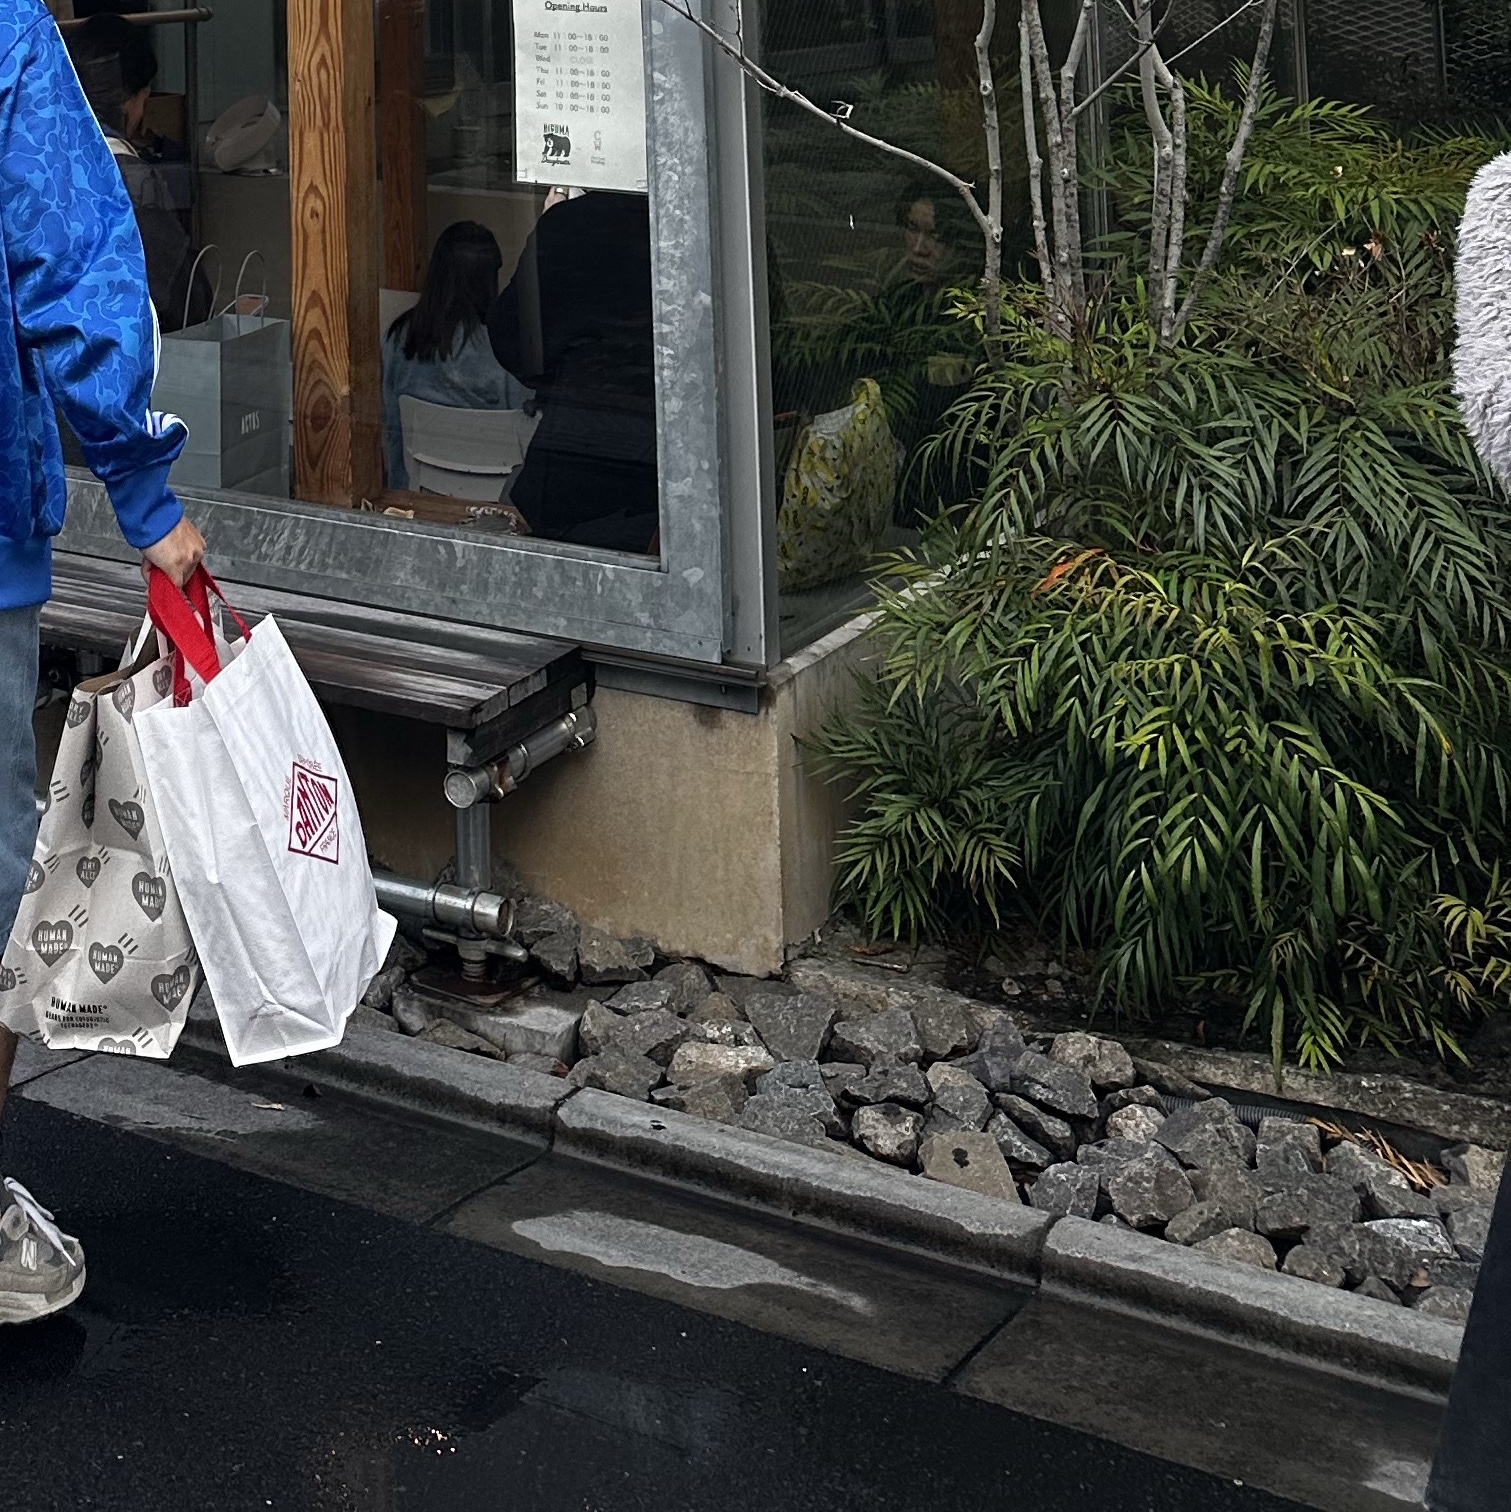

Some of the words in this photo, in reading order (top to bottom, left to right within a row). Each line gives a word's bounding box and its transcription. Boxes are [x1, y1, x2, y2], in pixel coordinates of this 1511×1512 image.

[544, 0, 580, 13] Opening
[582, 2, 607, 13] Hours
[295, 771, 334, 849] DANTON
[37, 929, 67, 942] HUMAN
[92, 949, 118, 963] HUMAN
[50, 996, 77, 1014] HUMAN
